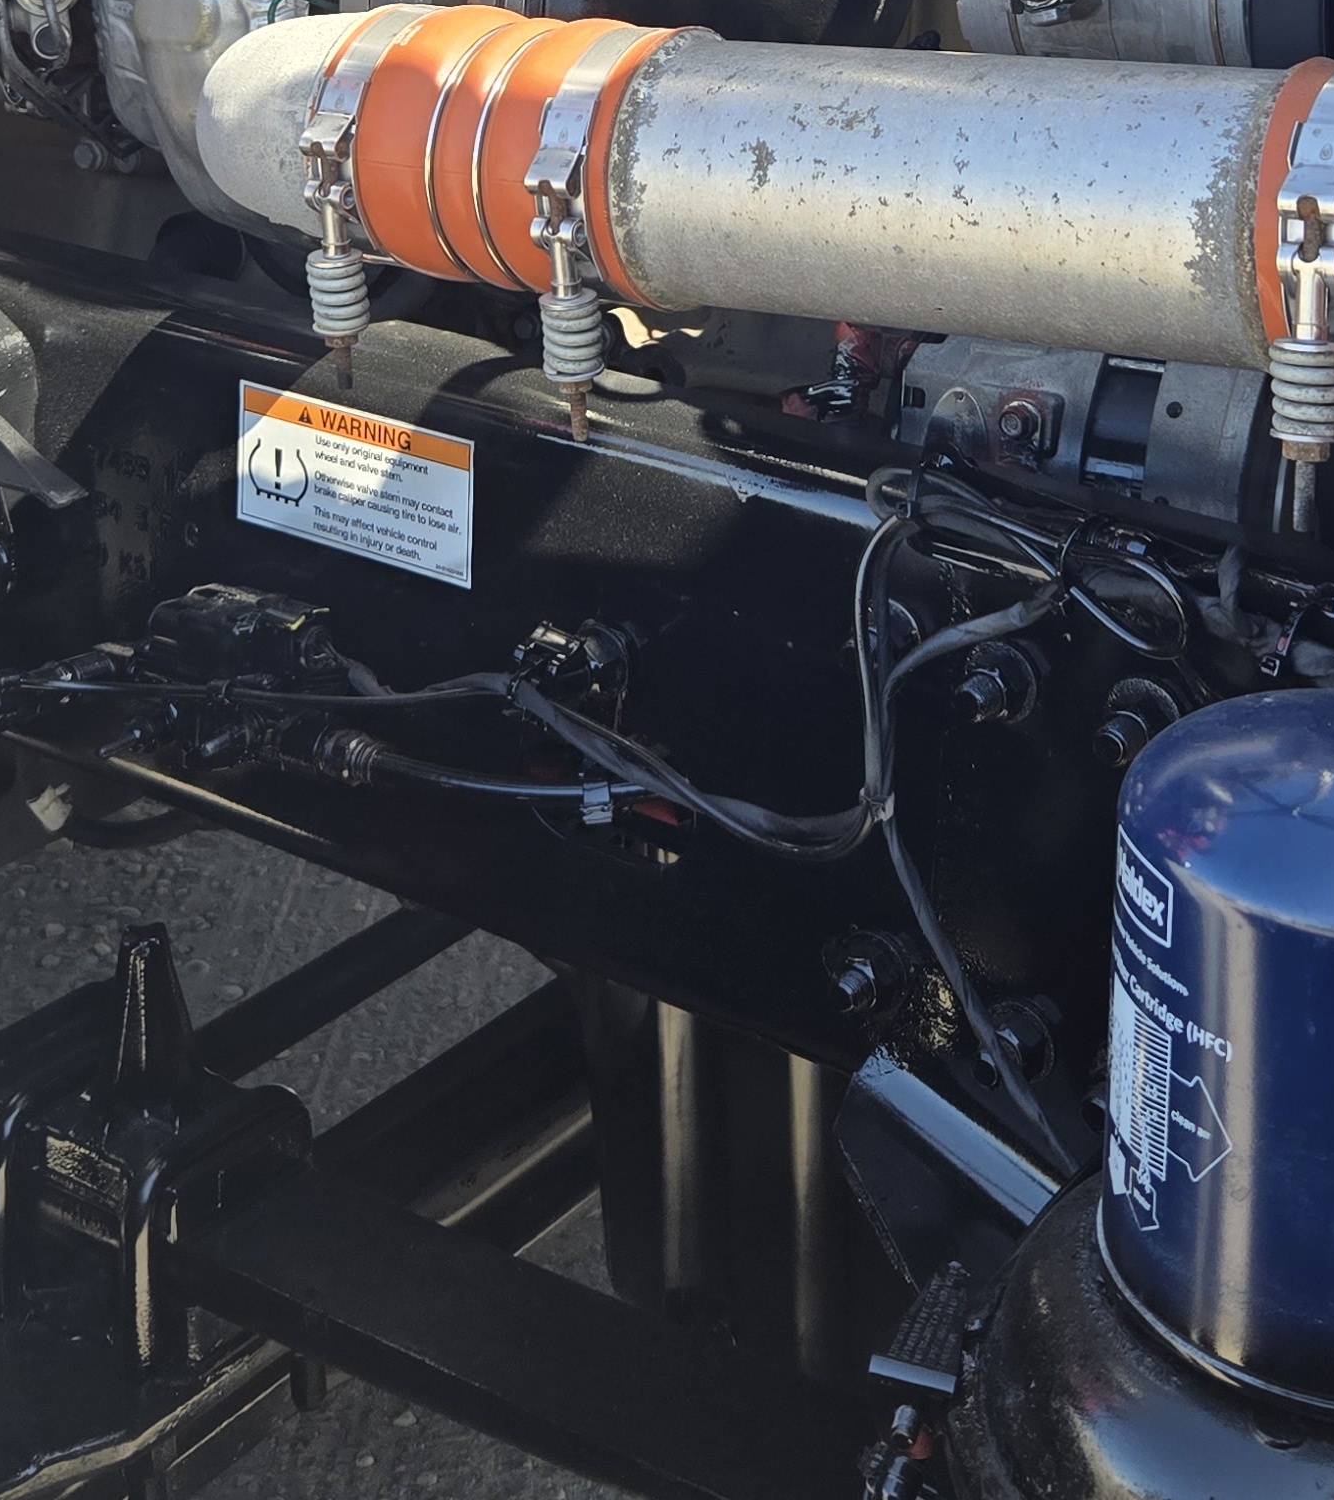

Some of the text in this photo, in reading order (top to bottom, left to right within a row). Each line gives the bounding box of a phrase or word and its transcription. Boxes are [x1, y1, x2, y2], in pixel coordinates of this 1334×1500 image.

[320, 409, 411, 451] WARNING
[315, 434, 429, 475] Use only original equipment
[315, 450, 403, 482] wheel and valve stem.
[314, 470, 453, 519] Otherwise valve stem may contact
[314, 483, 462, 535] brake caliper causing tire to lose air.
[313, 505, 438, 551] This may affect vehicle control
[313, 521, 422, 561] resulting in injury or death.
[1118, 845, 1165, 927] Haldex
[1146, 955, 1190, 997] Solutions
[1129, 974, 1234, 1063] Cartridge (HFC)
[1171, 1109, 1196, 1133] clean
